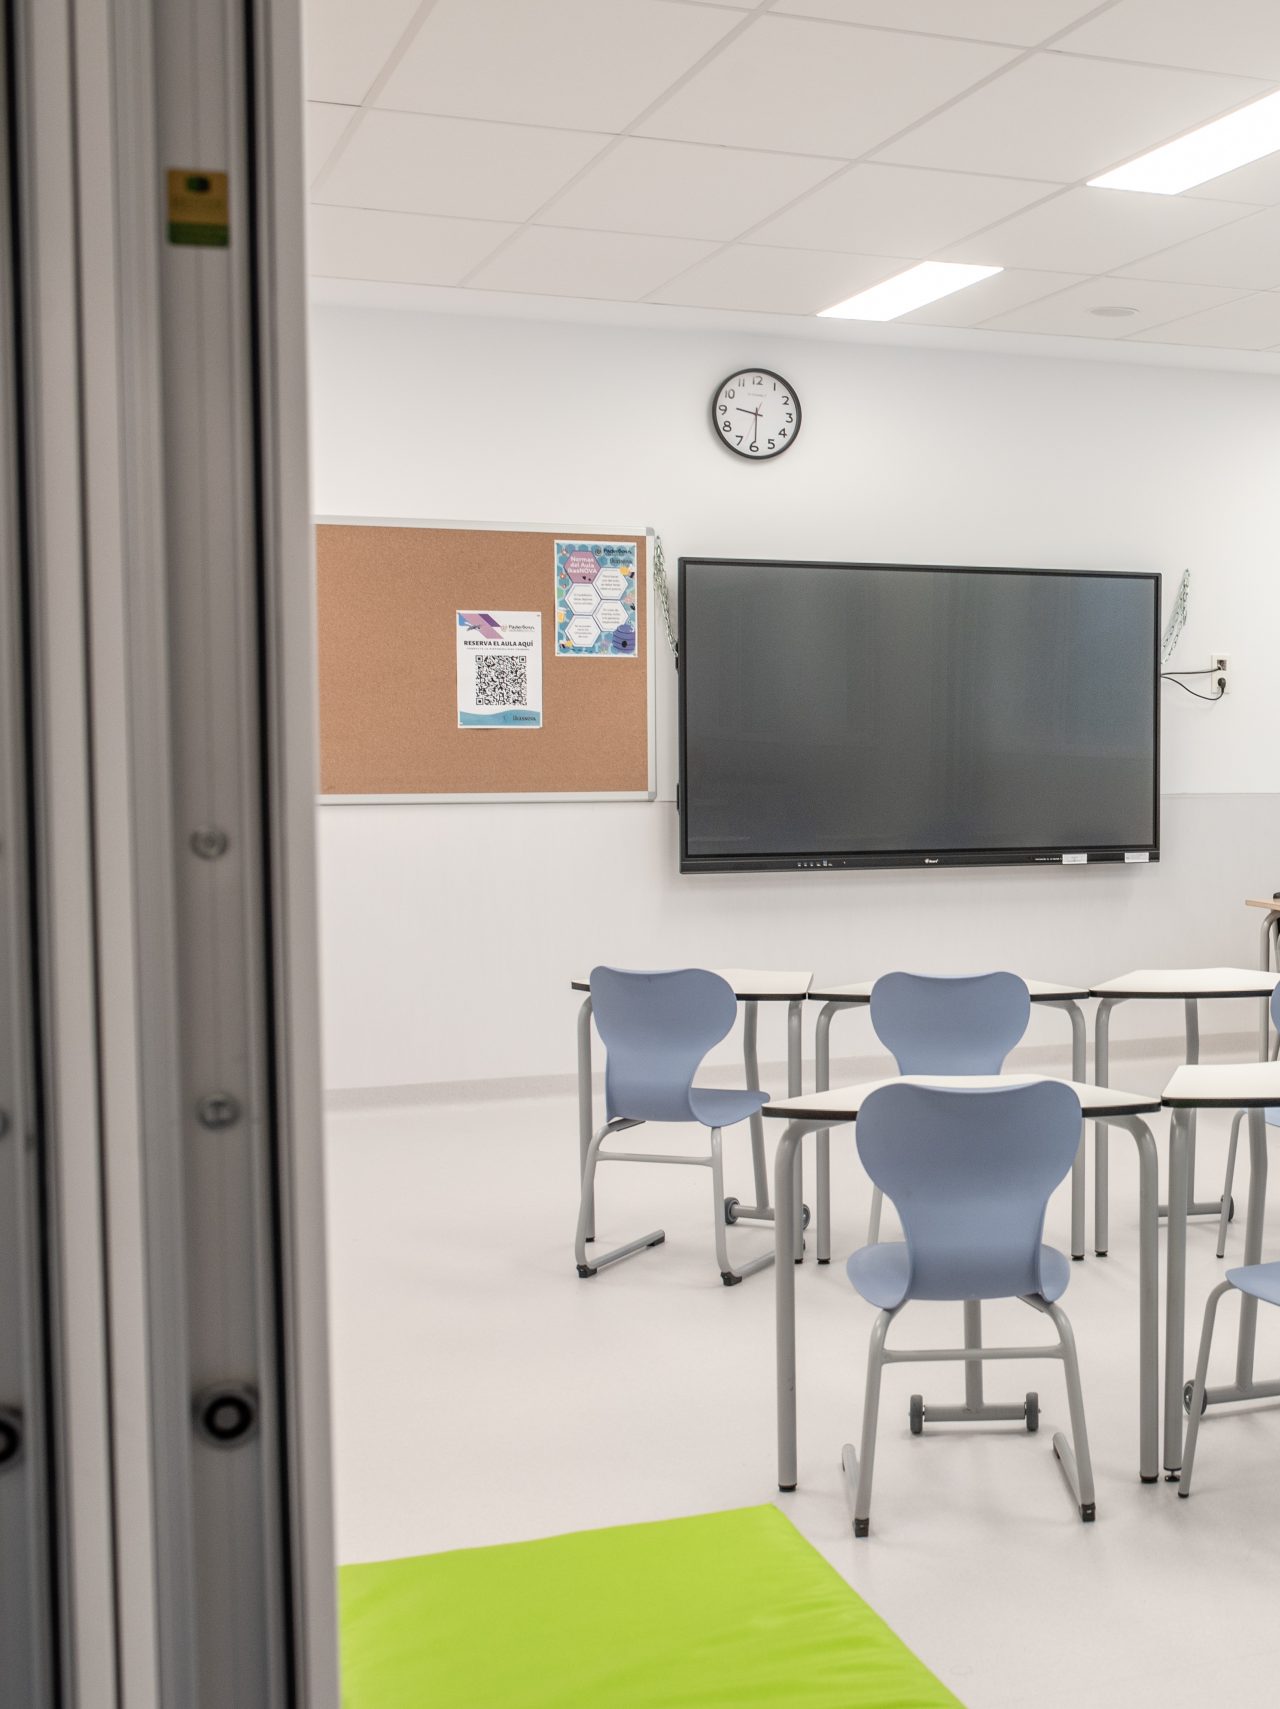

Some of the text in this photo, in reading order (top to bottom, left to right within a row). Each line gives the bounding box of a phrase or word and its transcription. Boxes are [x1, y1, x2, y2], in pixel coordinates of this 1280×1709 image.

[738, 378, 744, 387] 11
[752, 376, 763, 386] 12
[724, 389, 735, 400] 10
[782, 396, 790, 405] 2
[719, 404, 728, 415] 9
[786, 413, 794, 423] 3
[722, 420, 732, 432] 8
[778, 428, 787, 438] 4
[736, 435, 744, 446] 7
[749, 440, 759, 452] 6
[768, 439, 775, 450] 5
